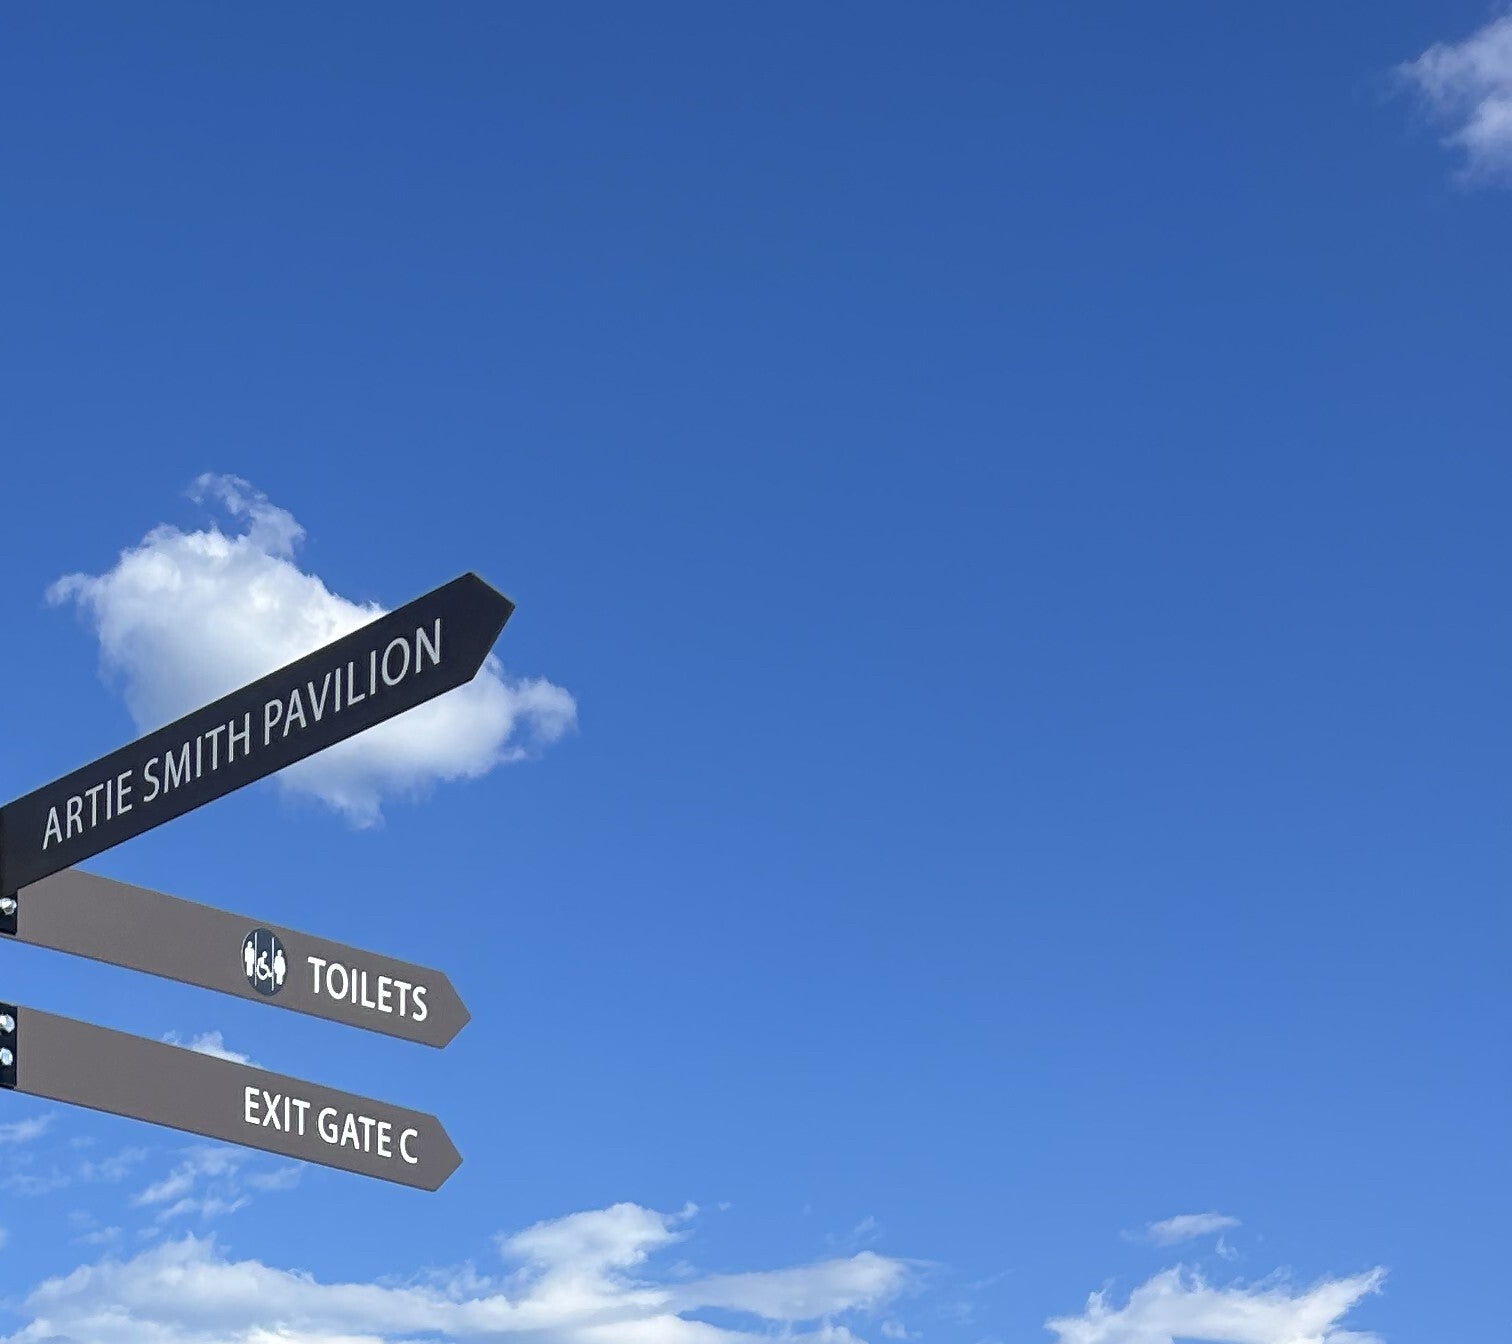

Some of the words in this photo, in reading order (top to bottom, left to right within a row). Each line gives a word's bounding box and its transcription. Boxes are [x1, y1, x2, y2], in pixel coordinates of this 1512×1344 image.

[42, 769, 133, 851] ARTIE
[143, 712, 251, 803] SMITH
[264, 617, 442, 746] PAVILION
[306, 956, 428, 1023] TOILETS
[243, 1086, 312, 1136] EXIT
[317, 1106, 393, 1159] GATE
[399, 1128, 419, 1165] C
